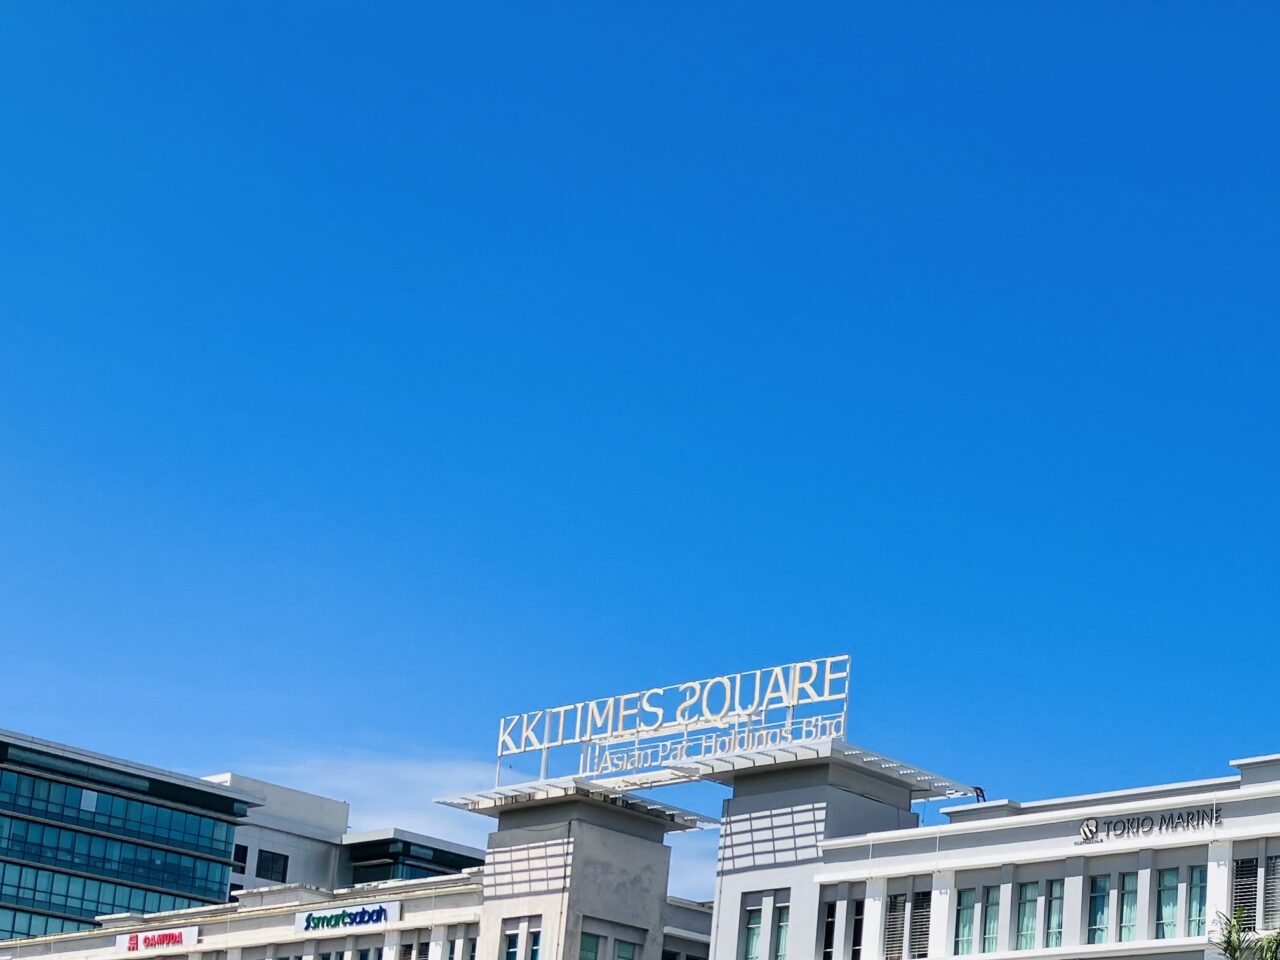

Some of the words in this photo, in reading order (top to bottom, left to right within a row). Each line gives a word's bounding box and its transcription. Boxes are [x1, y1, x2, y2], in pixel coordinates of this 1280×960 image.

[497, 711, 544, 757] KK
[550, 688, 664, 745] TIMES
[676, 655, 849, 729] SQUARE
[600, 749, 651, 775] Asian
[659, 740, 693, 766] Pac
[802, 711, 846, 741] Bhd
[1104, 816, 1154, 837] TOKIO
[1159, 808, 1222, 831] MARINE
[144, 931, 183, 948] GAMUDA
